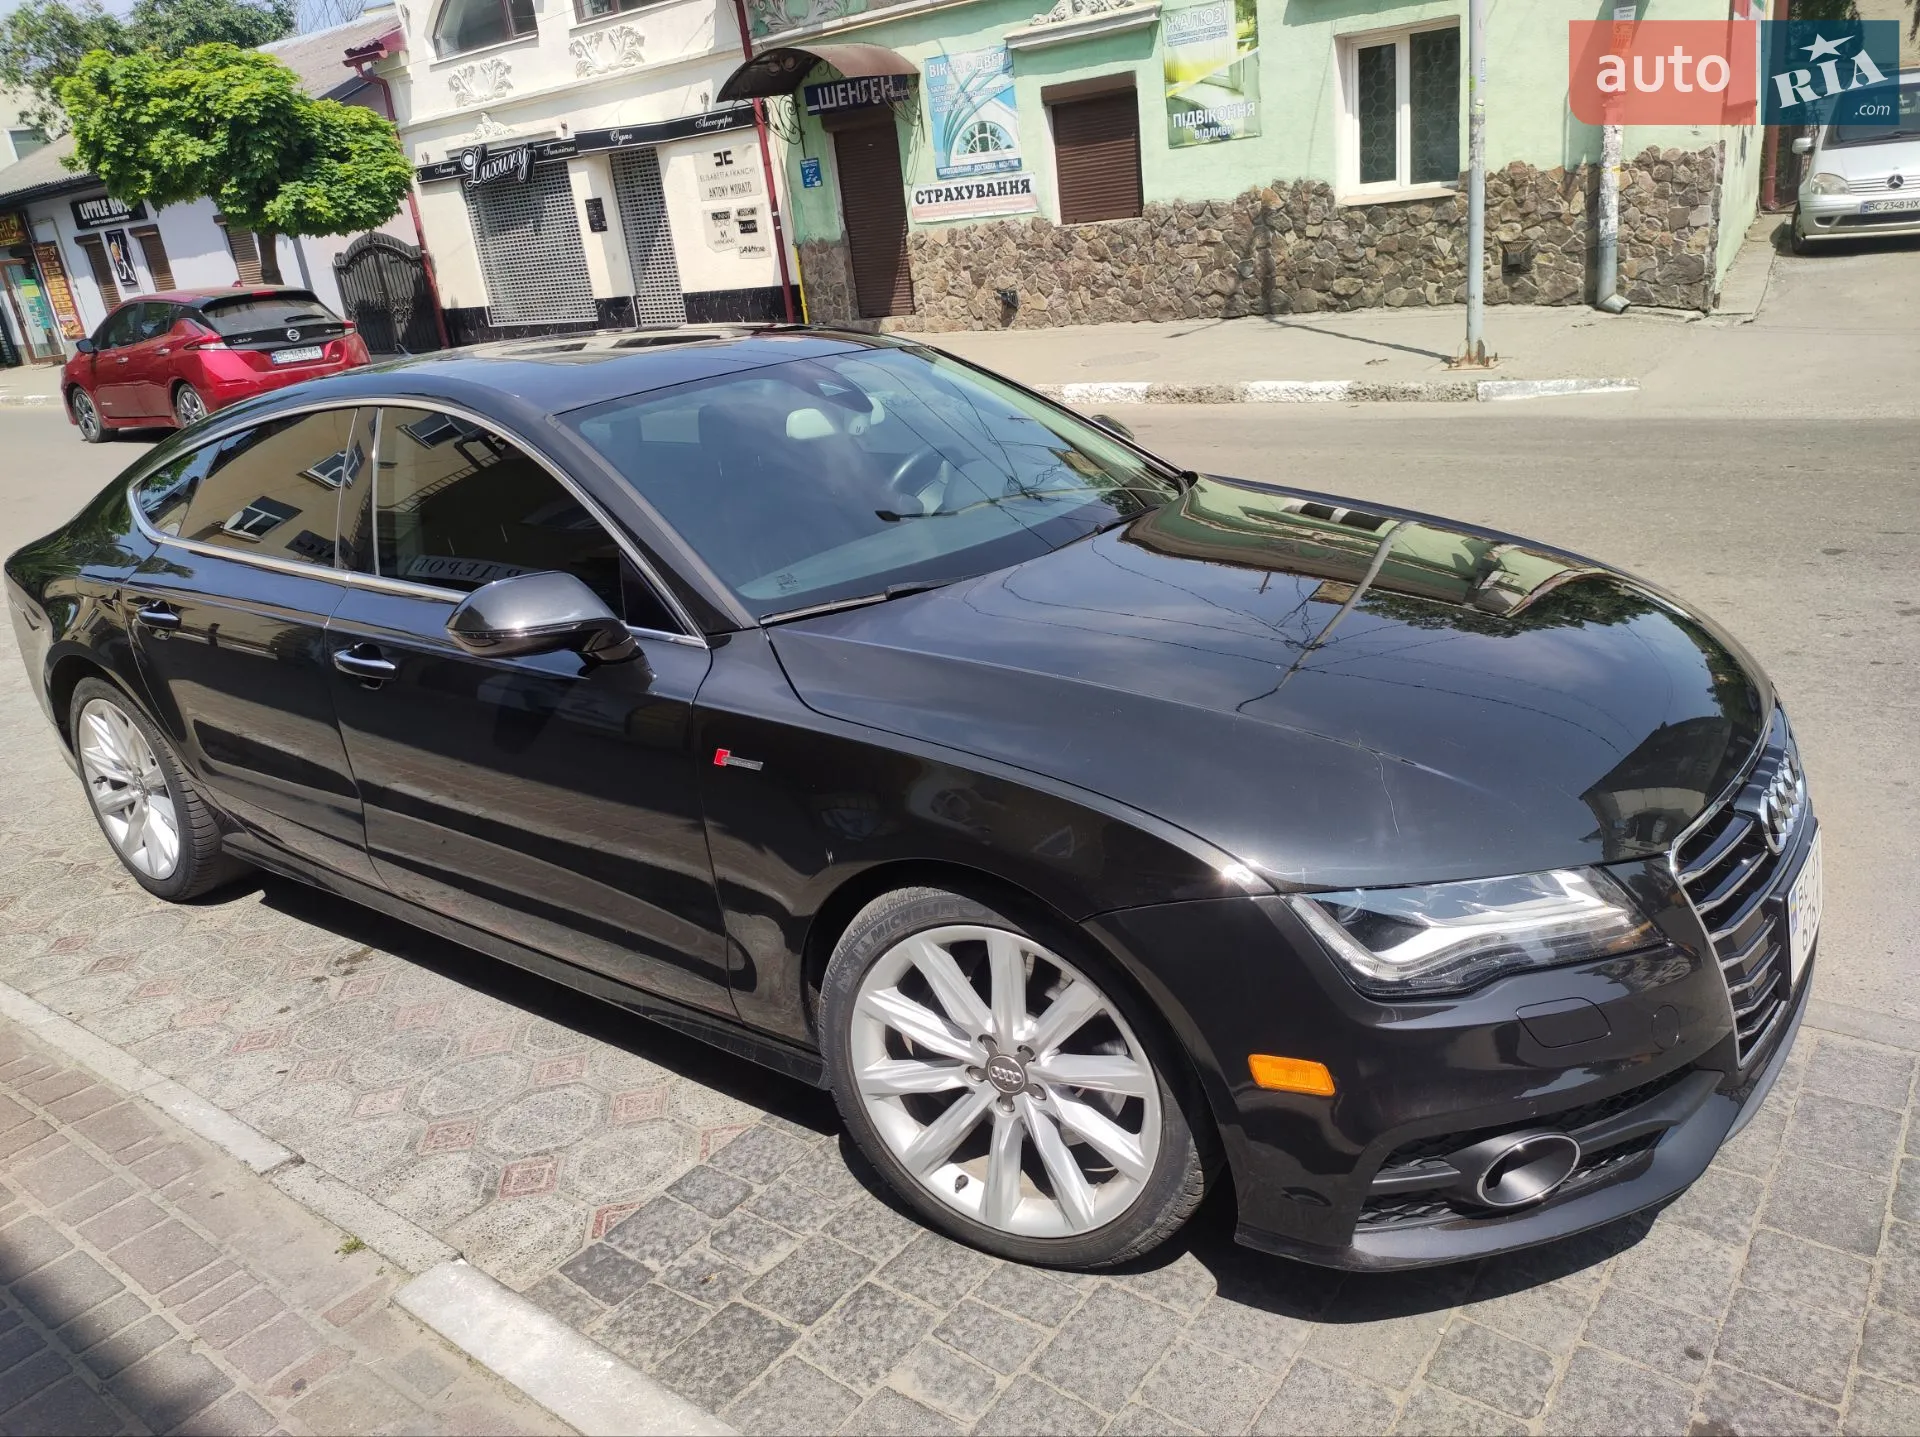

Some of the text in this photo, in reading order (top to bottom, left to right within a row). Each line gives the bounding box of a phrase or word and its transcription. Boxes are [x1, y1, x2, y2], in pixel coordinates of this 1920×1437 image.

[1166, 7, 1227, 33] ЖАЛЮЗІ
[975, 51, 1010, 70] ДВЕРІ
[1172, 102, 1256, 129] ПІДВІКОННЯ
[1194, 125, 1235, 140] ВІДЛИВИ
[461, 144, 530, 187] Luxury
[915, 179, 1032, 206] СТРАХУВАННЯ
[79, 199, 110, 220] LITTLE
[870, 902, 960, 944] MICHELIN
